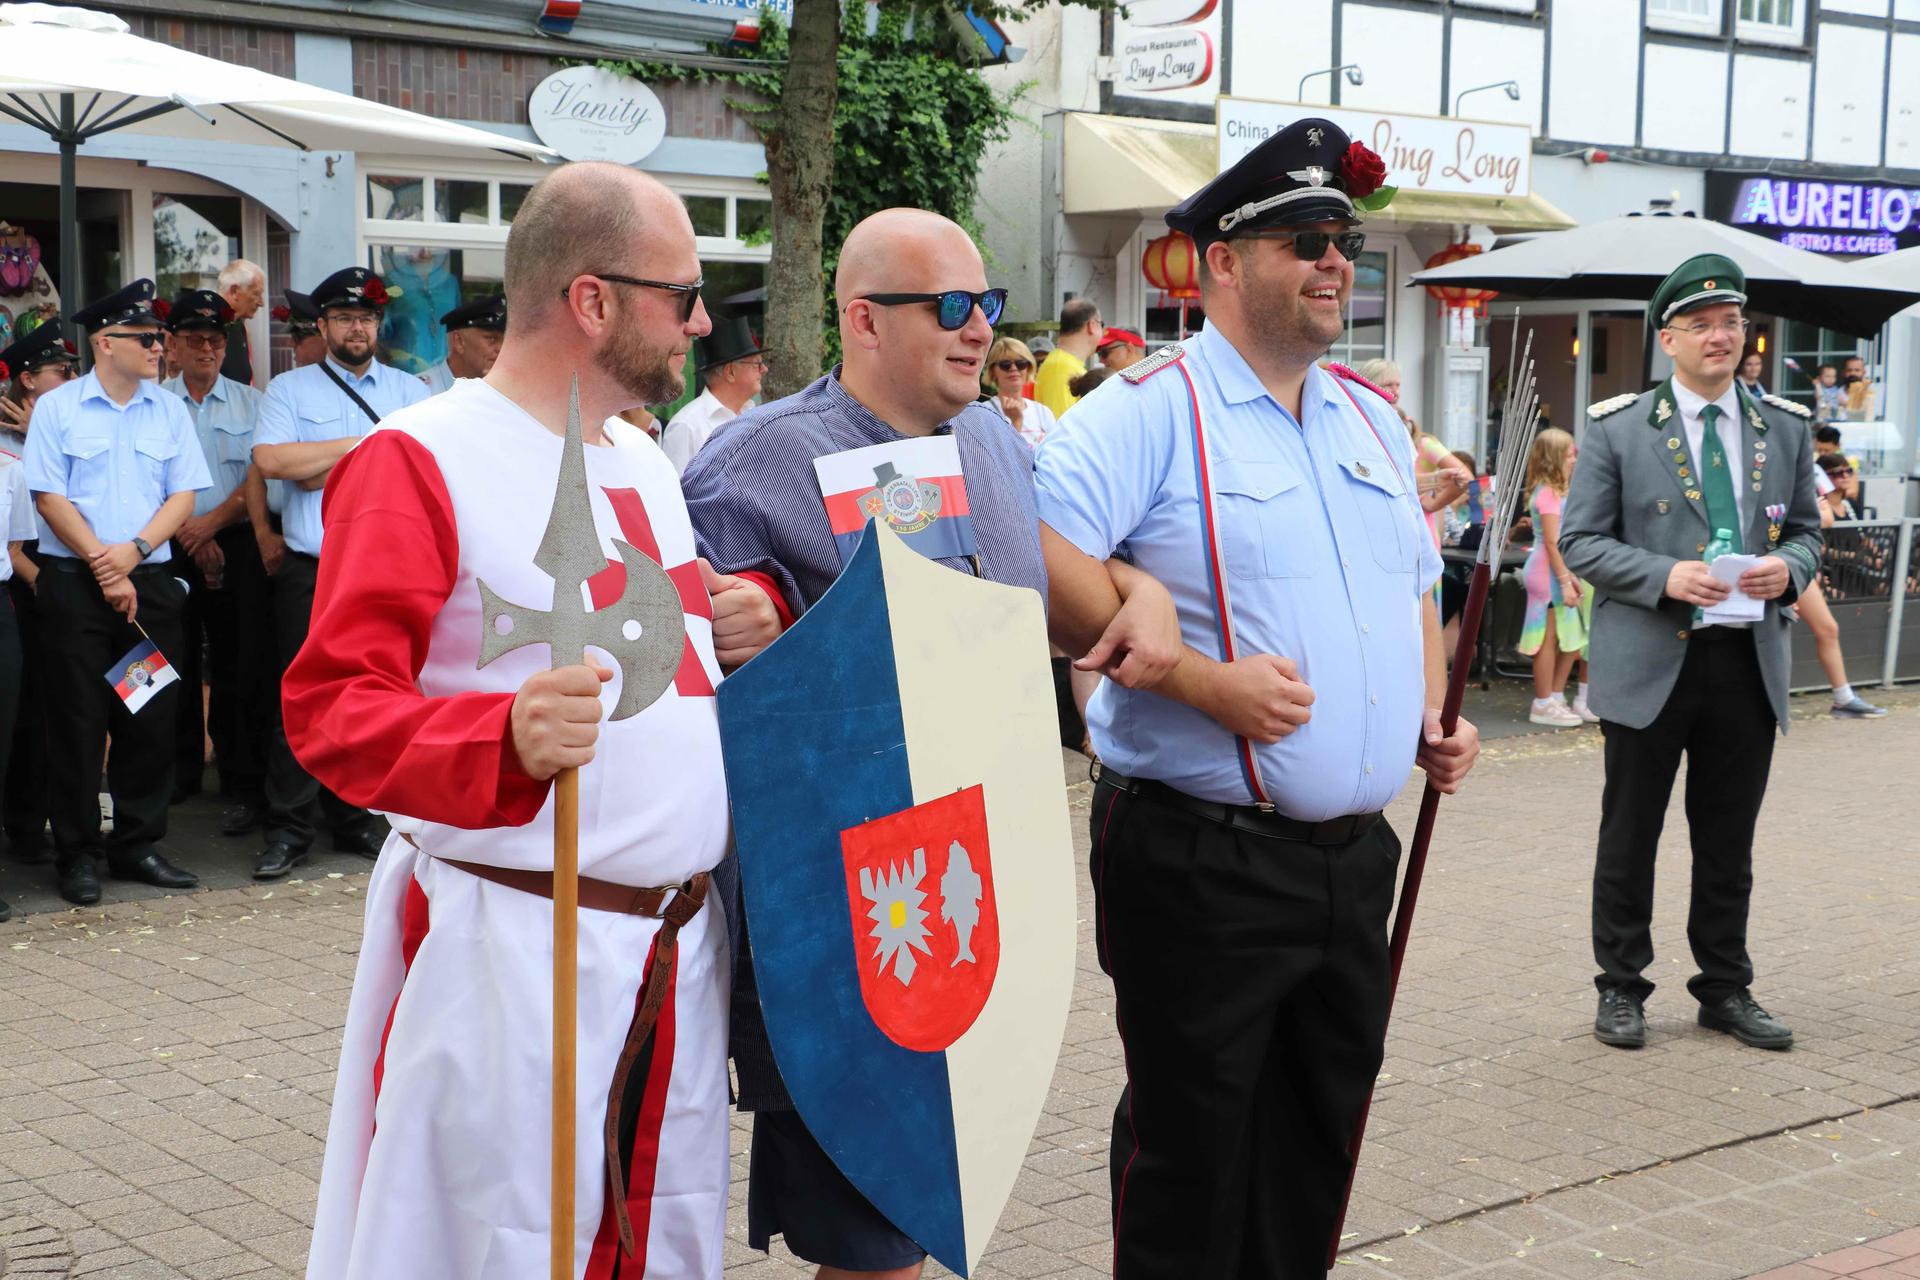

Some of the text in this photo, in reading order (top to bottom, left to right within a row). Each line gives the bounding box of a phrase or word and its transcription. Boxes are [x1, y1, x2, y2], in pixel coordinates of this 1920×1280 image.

[1125, 38, 1198, 55] China Restaurant
[1125, 53, 1195, 84] Ling Long
[548, 79, 649, 136] Vanity
[1226, 119, 1269, 140] China
[1441, 127, 1521, 194] Long
[1787, 232, 1831, 251] BISTRO
